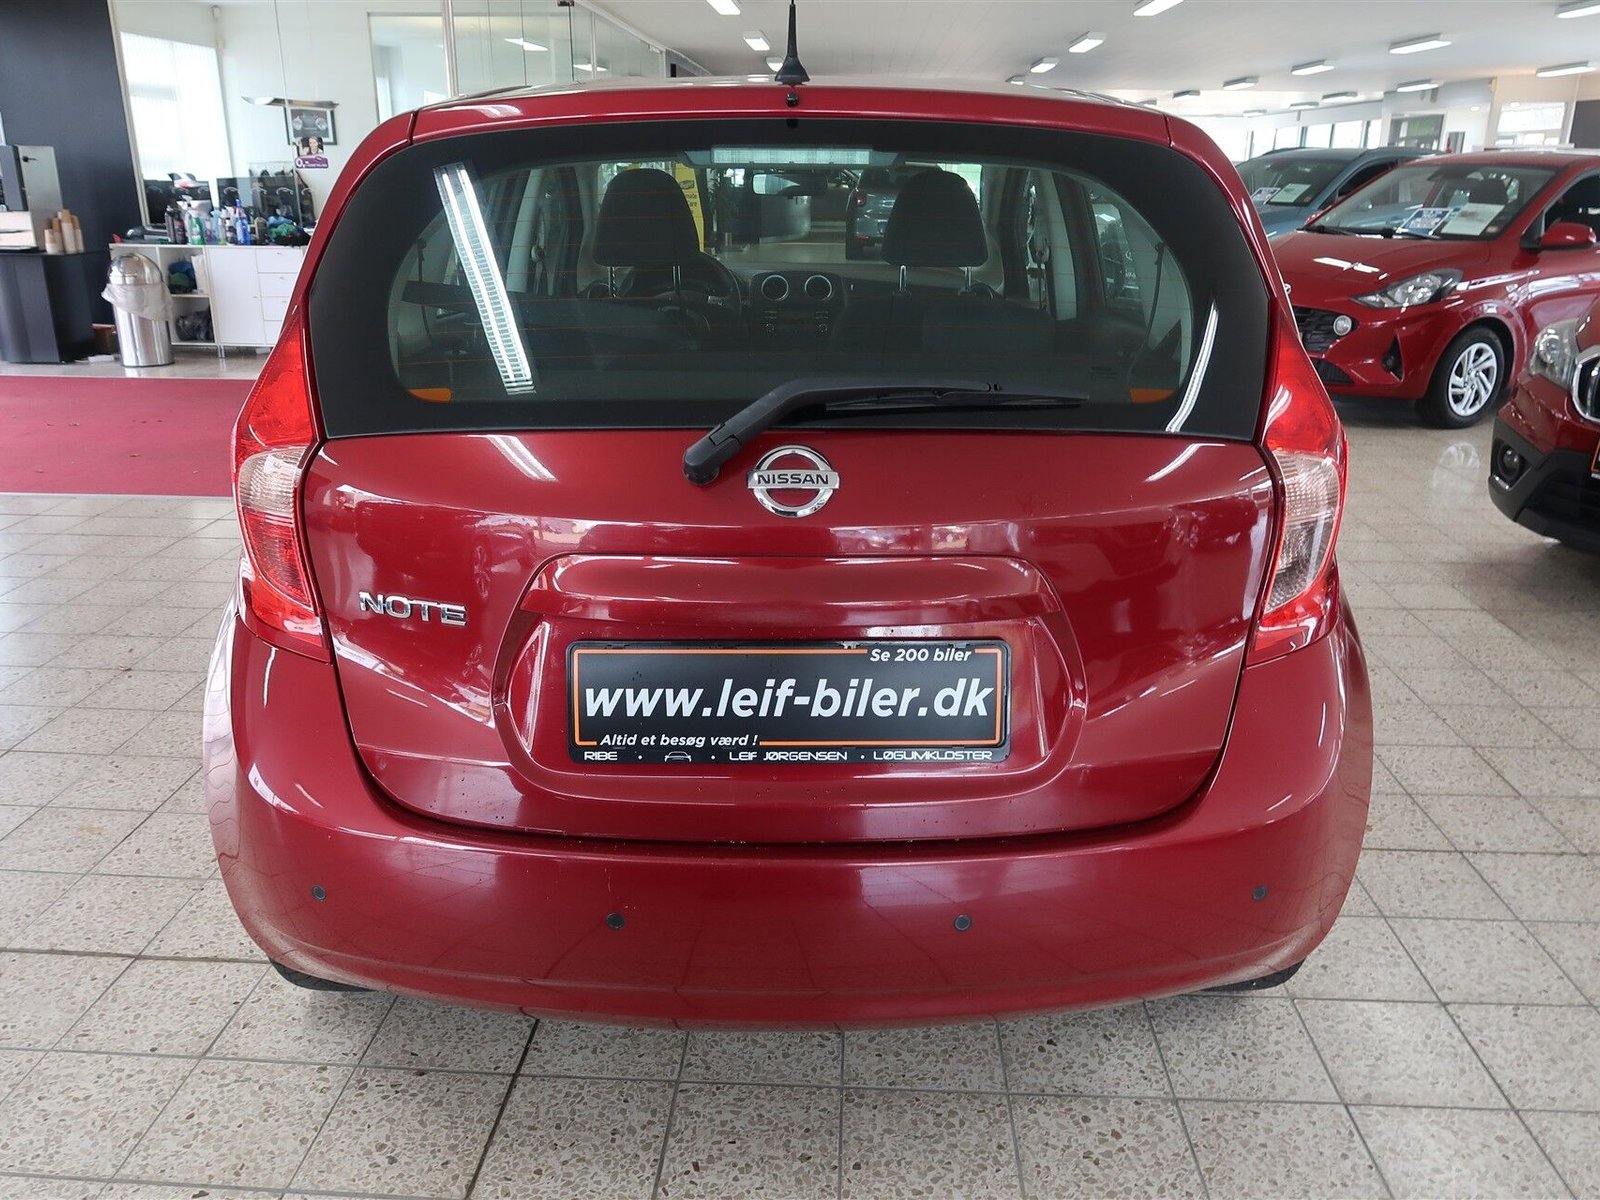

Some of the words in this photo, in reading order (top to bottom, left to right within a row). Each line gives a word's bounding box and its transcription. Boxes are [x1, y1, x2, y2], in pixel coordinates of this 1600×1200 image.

[757, 473, 829, 485] NISSAN
[358, 591, 467, 626] NOTE
[869, 649, 890, 662] Se
[895, 649, 929, 662] 200
[933, 648, 971, 662] biler
[585, 678, 994, 717] www.leif-biler.dk
[600, 734, 637, 746] Altid
[641, 735, 656, 746] et
[660, 734, 705, 747] besøg
[709, 734, 749, 746] værd
[752, 734, 760, 746] !
[584, 752, 618, 761] RIBE
[729, 752, 758, 761] LEIF
[763, 751, 848, 762] JØRGENSEN
[873, 751, 993, 761] LØGUMKLOSTER
